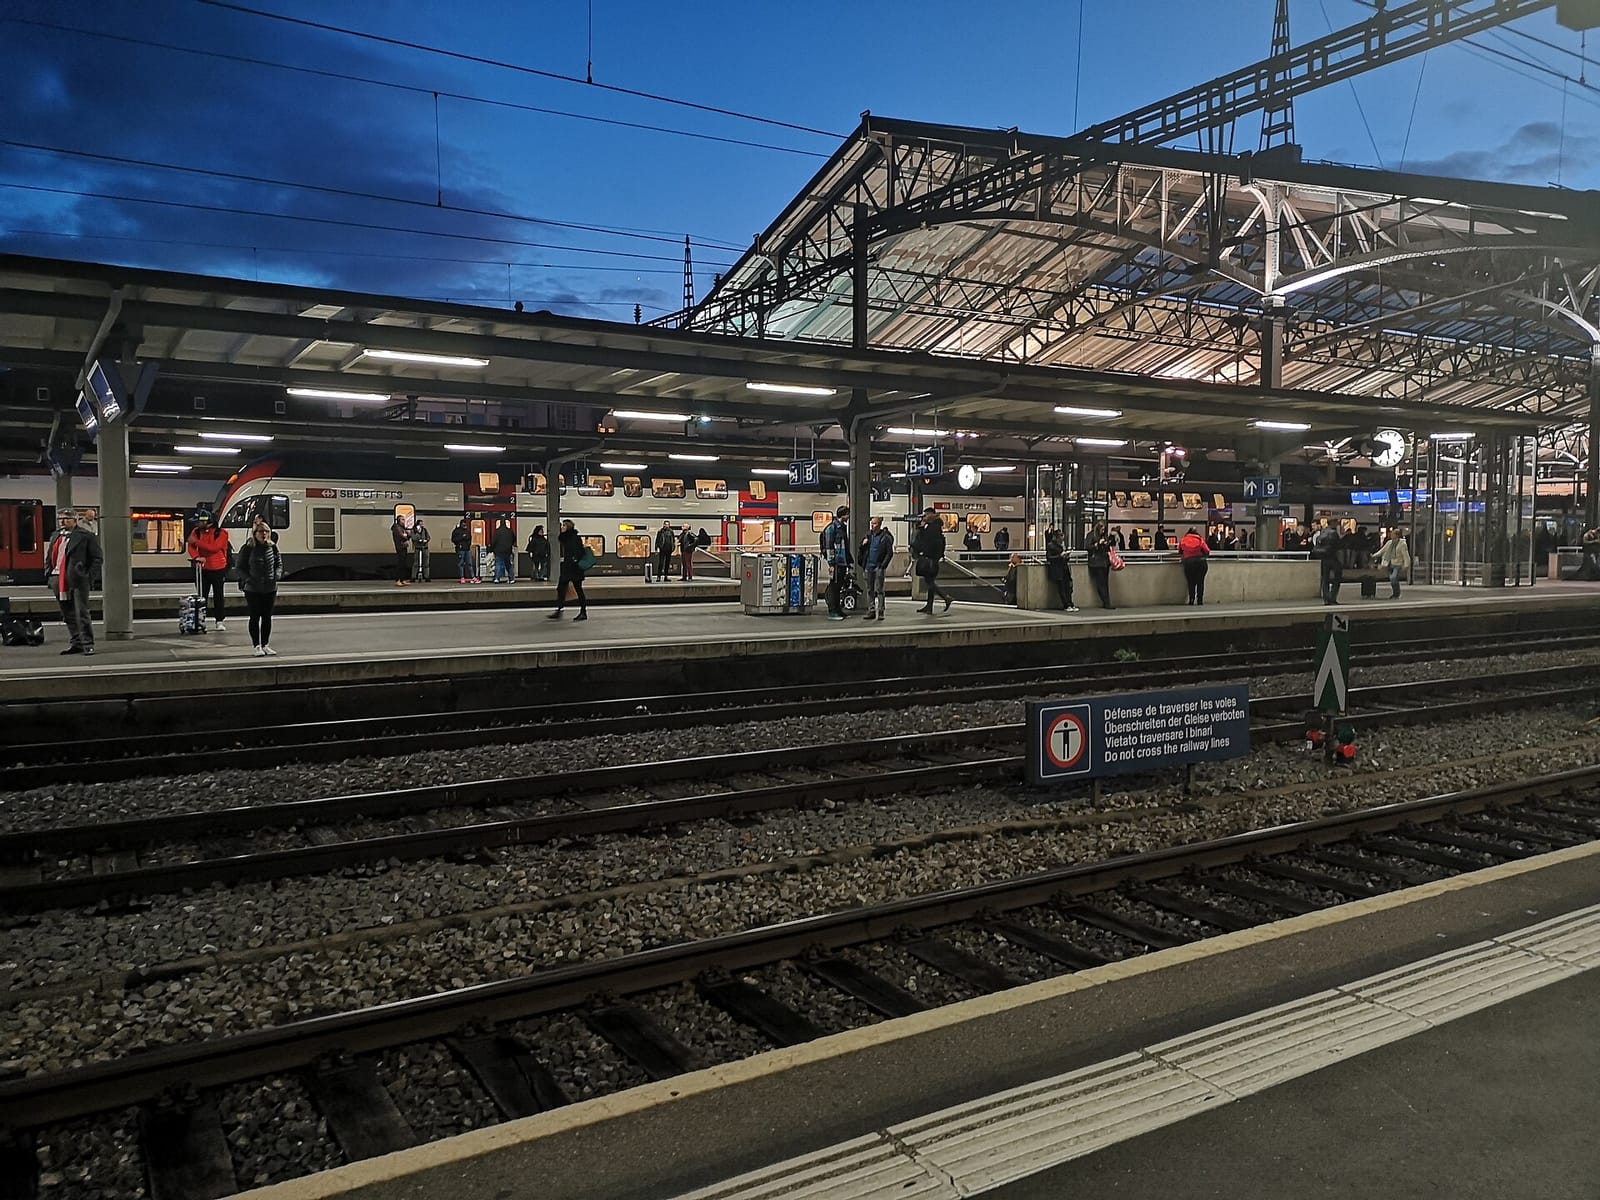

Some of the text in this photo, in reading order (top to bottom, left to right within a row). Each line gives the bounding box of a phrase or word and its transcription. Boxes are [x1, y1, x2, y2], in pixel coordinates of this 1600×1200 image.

[806, 468, 813, 481] B
[910, 457, 935, 473] B 3
[340, 489, 360, 498] SBB
[1267, 483, 1275, 494] 9
[1104, 697, 1237, 720] Défense de traverser les voies
[1104, 709, 1245, 734] Überschreiten der Gleise verboten
[1105, 735, 1138, 748] Vietato
[1140, 729, 1184, 744] traversare
[1189, 725, 1213, 738] binari
[1104, 736, 1230, 763] Do not cross the railway lines
